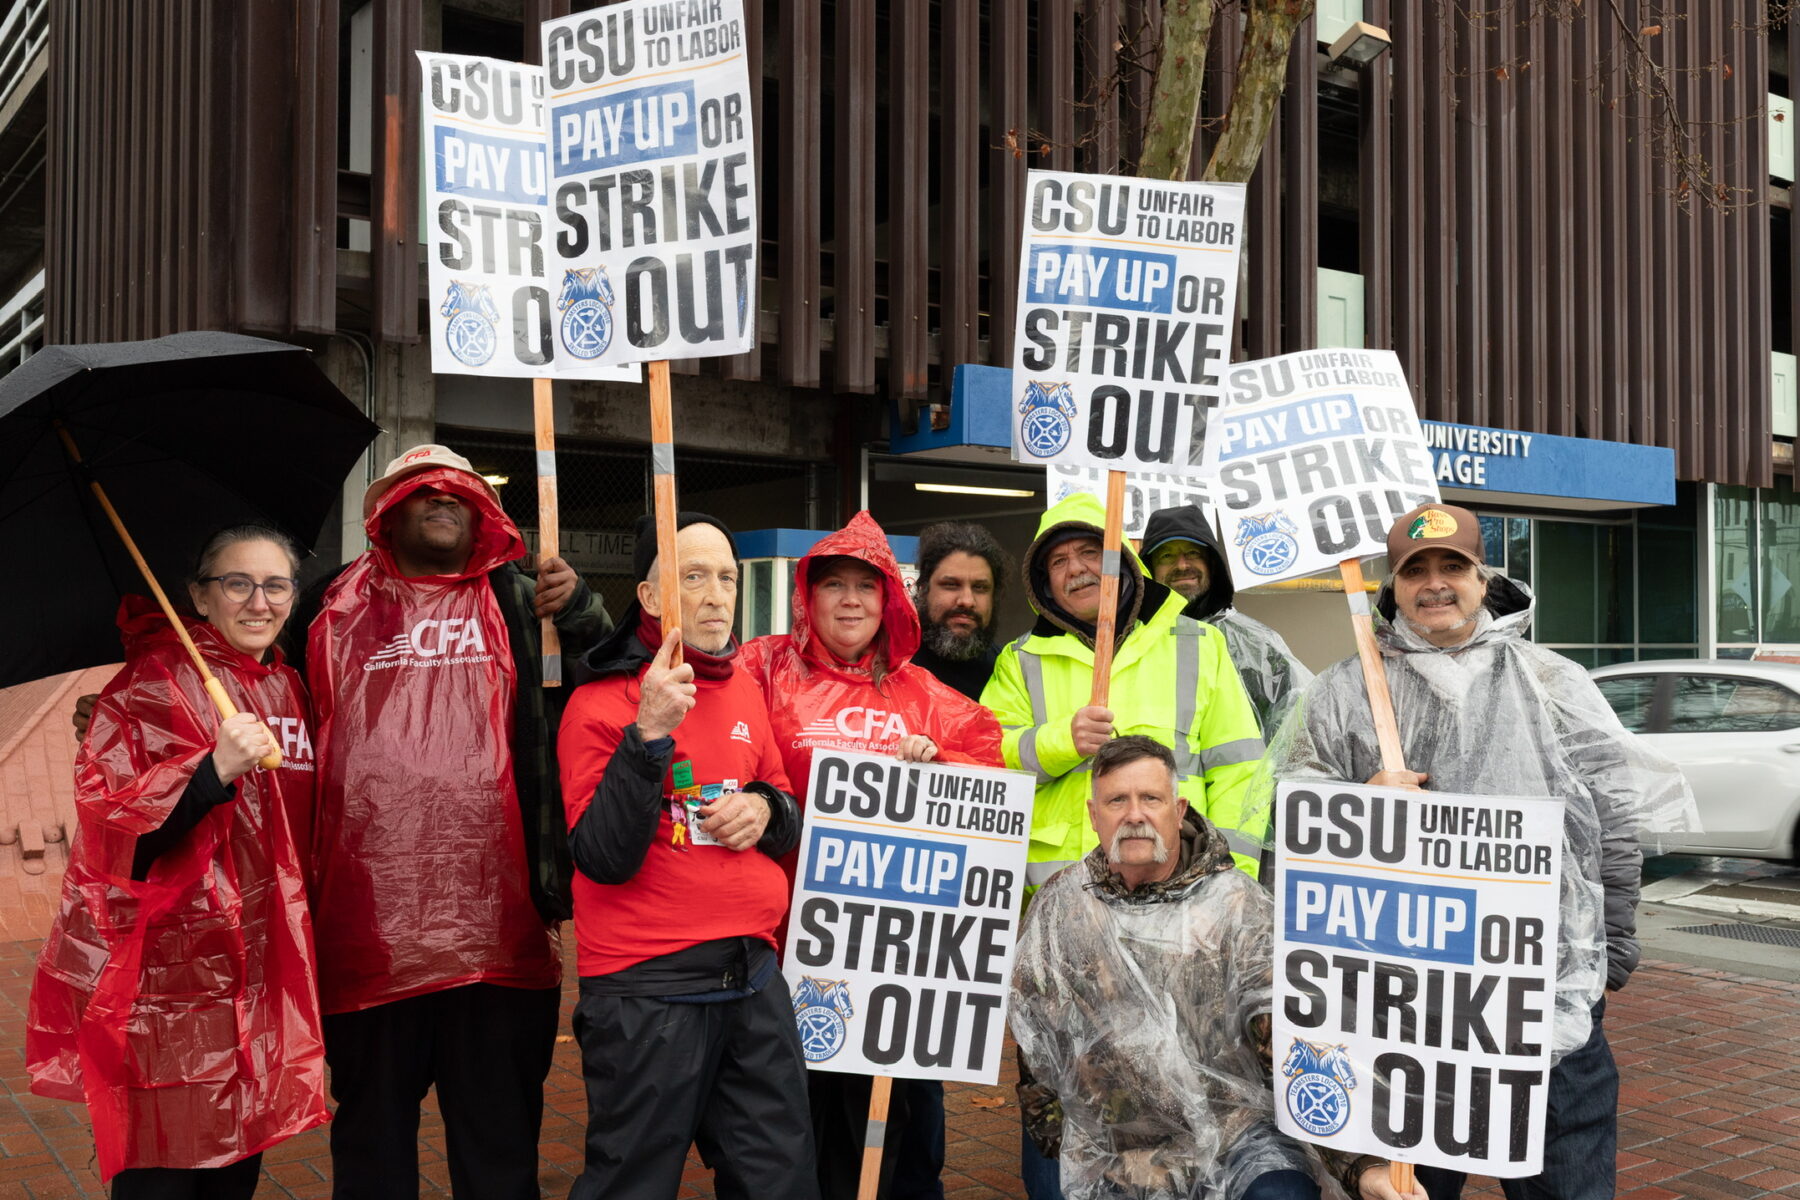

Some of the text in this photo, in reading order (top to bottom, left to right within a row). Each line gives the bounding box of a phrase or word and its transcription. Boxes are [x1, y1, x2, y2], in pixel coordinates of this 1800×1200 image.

[643, 0, 722, 35] UNFAIR
[644, 19, 740, 68] TO LABOR
[548, 9, 635, 90] CSU
[430, 59, 523, 125] CSU
[560, 91, 743, 165] PAY UP OR
[444, 136, 511, 192] PAY
[555, 152, 750, 259] STRIKE
[1031, 179, 1130, 236] CSU
[1137, 214, 1234, 245] TO LABOR
[1139, 188, 1214, 217] UNFAIR
[438, 199, 545, 277] STR
[625, 244, 752, 349] OUT
[1035, 252, 1225, 315] PAY UP OR
[1023, 308, 1224, 386] STRIKE
[1298, 352, 1374, 372] UNFAIR
[1226, 359, 1295, 407] SU
[1302, 368, 1401, 389] TO LABOR
[1087, 384, 1219, 466] OUT
[1221, 399, 1413, 455] PAY UP OR
[1424, 424, 1532, 458] UNIVERSITY
[1220, 438, 1430, 510] STRIKE
[585, 533, 633, 556] TIME
[363, 656, 408, 671] California
[409, 657, 441, 668] Faculty
[410, 618, 485, 657] CFA
[791, 737, 900, 751] California Faculty Associa
[836, 706, 909, 740] CFA
[814, 757, 920, 823] CSU
[929, 772, 1007, 806] UNFAIR
[926, 800, 1025, 836] TO LABOR
[1285, 790, 1407, 864] CSU
[1420, 803, 1523, 840] UNFAIR
[814, 836, 1014, 909] PAY UP OR
[1418, 837, 1552, 875] TO LABOR
[795, 897, 1010, 984] STRIKE
[1295, 880, 1544, 966] PAY UP OR
[862, 984, 1002, 1071] OUT
[1284, 949, 1545, 1057] STRIKE
[1290, 1074, 1320, 1097] TEAMSTERS
[1321, 1075, 1340, 1092] LOCAL
[1371, 1052, 1543, 1163] OUT
[1294, 1112, 1340, 1133] SKILLED TRADES
